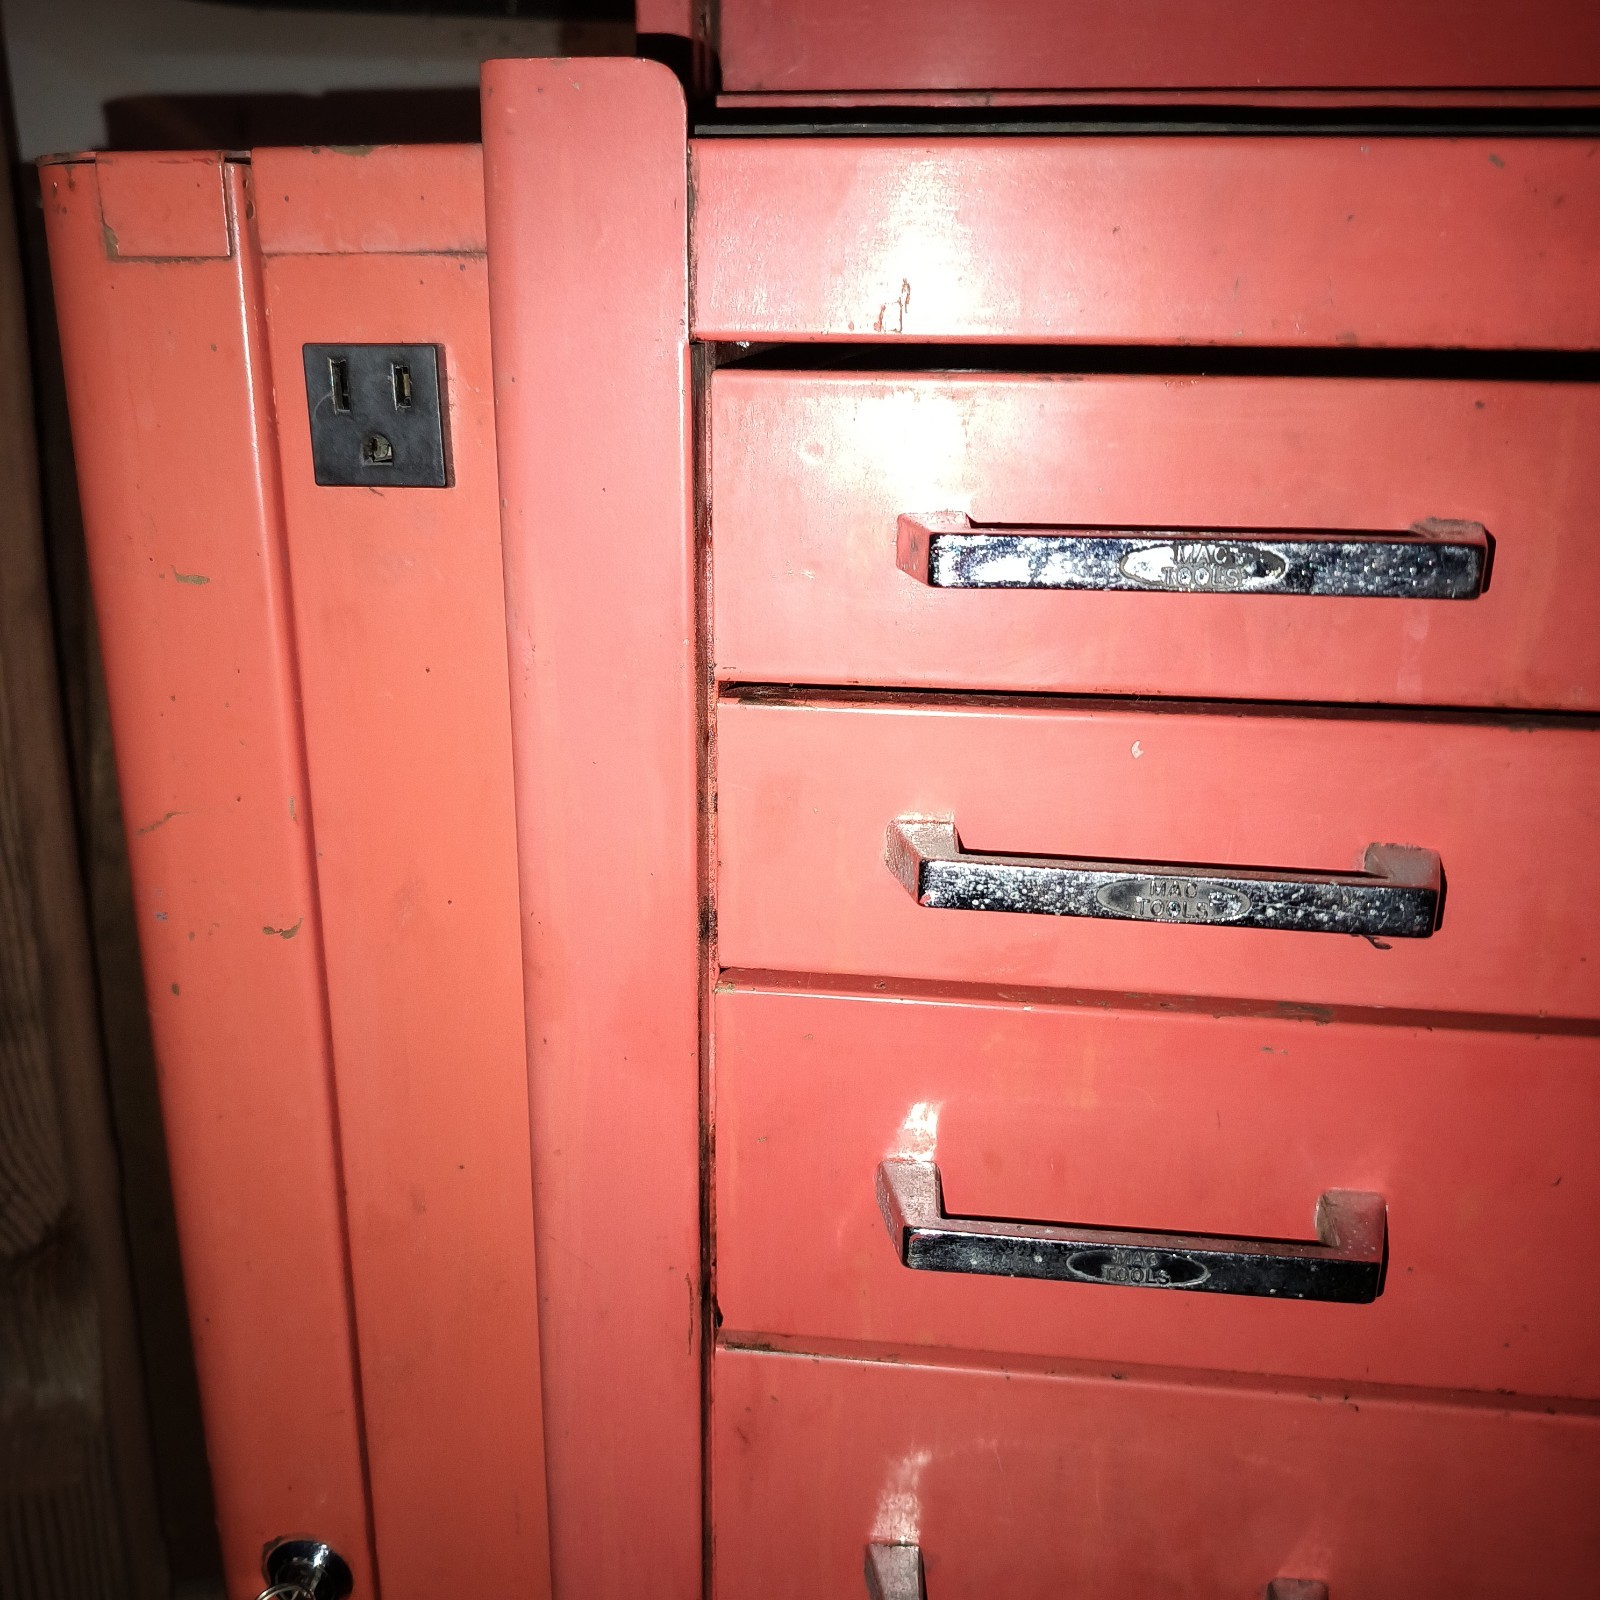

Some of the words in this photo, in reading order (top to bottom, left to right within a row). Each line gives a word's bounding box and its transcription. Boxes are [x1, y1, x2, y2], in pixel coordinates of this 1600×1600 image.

[1176, 544, 1227, 565] MAC
[1162, 566, 1239, 587] TOOLS
[1150, 881, 1198, 898] MAC
[1136, 898, 1209, 919] TOOLS
[1111, 1250, 1159, 1266] MAC
[1103, 1265, 1171, 1285] TOOLS
